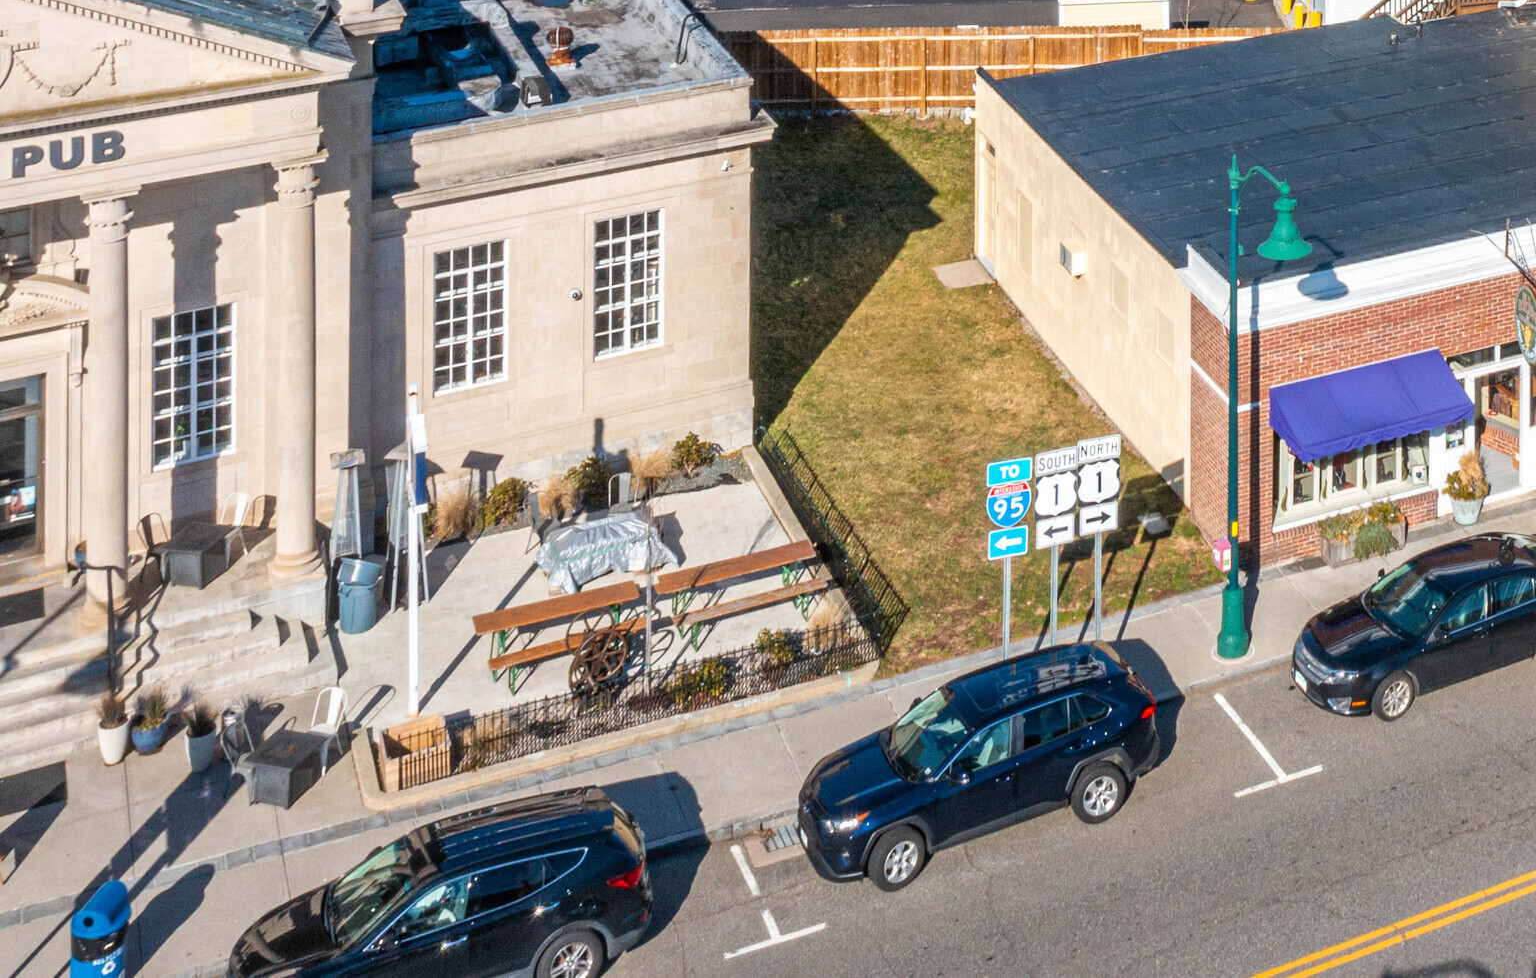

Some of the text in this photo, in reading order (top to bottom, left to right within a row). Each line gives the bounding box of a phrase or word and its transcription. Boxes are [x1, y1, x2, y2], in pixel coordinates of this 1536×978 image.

[12, 130, 126, 178] PUB
[1080, 441, 1118, 458] NORTH
[999, 464, 1020, 480] TO
[1038, 454, 1075, 472] SOUTH
[1096, 471, 1102, 493] 1
[1053, 483, 1059, 506] 1
[993, 496, 1024, 520] 95
